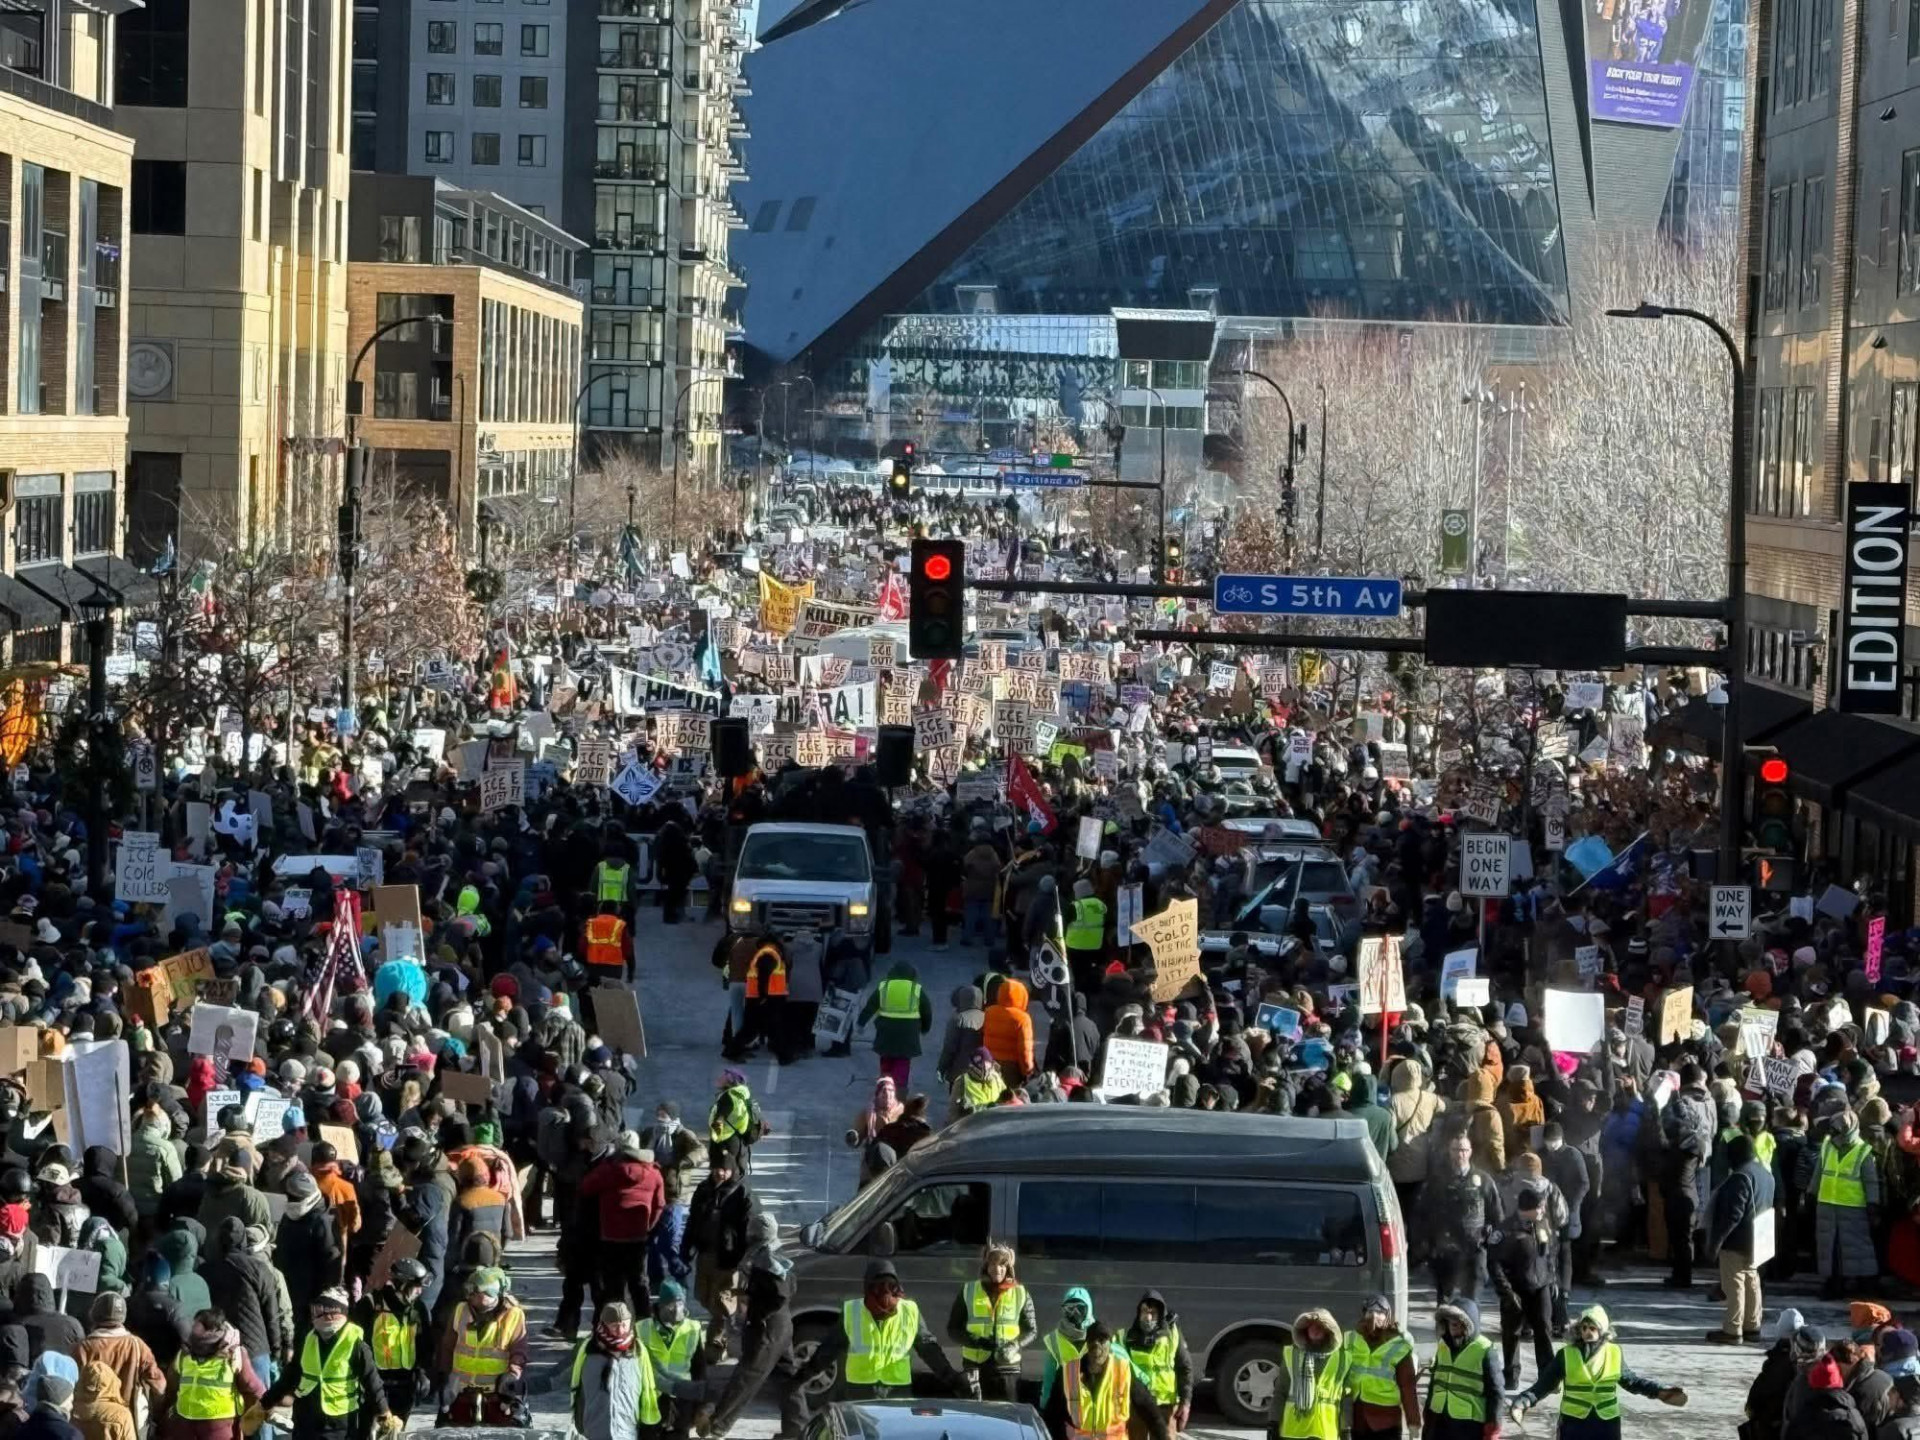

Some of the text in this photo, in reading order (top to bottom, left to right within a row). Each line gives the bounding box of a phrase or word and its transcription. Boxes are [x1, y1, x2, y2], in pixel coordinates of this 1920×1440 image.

[1017, 476, 1080, 485] Portland Av
[1260, 584, 1393, 609] S 5th Av
[1847, 506, 1905, 691] EDITION
[805, 606, 851, 626] KILLER
[853, 613, 875, 628] ICE
[998, 709, 1025, 723] ICE
[680, 720, 707, 733] ICE
[919, 719, 942, 733] ICE
[997, 723, 1025, 737] OUT!
[677, 733, 707, 747] OUT!
[921, 731, 948, 747] OUT!
[766, 744, 792, 757] ICE
[580, 752, 604, 766] ICE
[579, 767, 605, 779] OUT!
[484, 776, 506, 793] ICE
[1466, 840, 1507, 855] BEGIN
[127, 848, 156, 863] ICE
[1470, 858, 1503, 873] ONE
[1468, 876, 1503, 891] WAY
[1716, 890, 1745, 902] ONE
[1715, 904, 1745, 918] WAY
